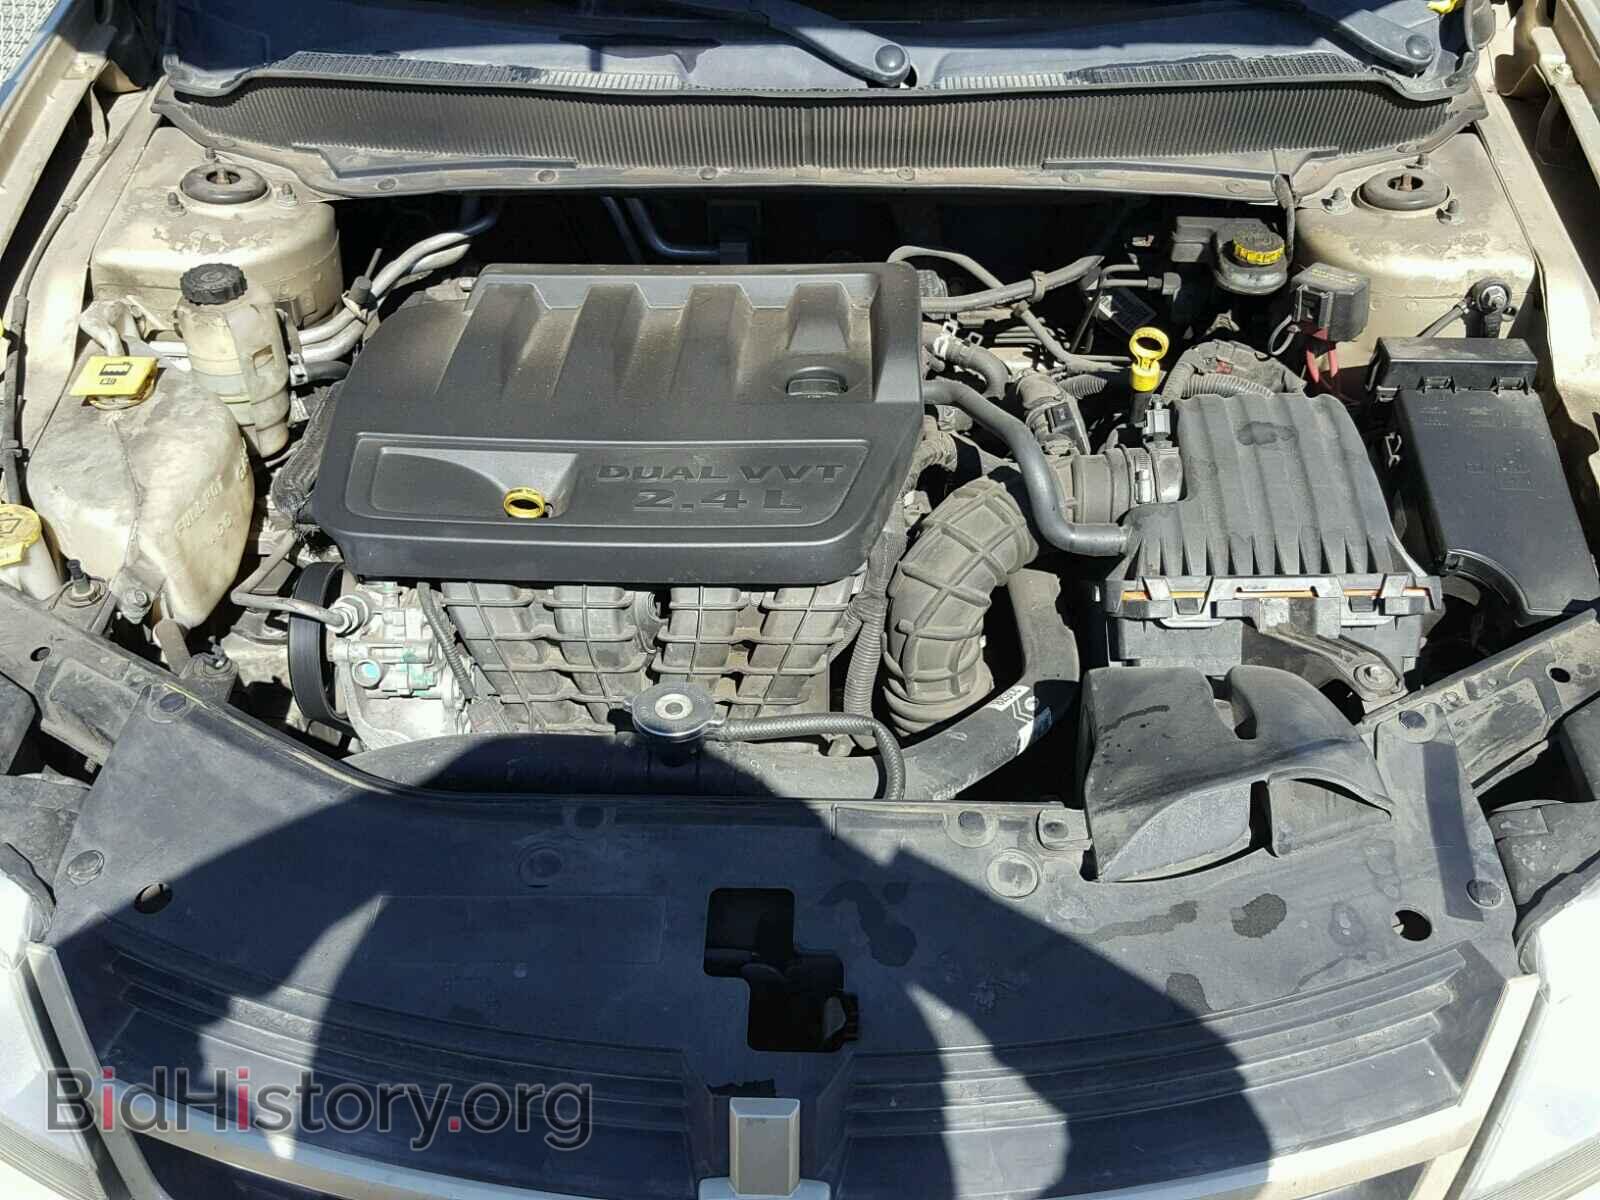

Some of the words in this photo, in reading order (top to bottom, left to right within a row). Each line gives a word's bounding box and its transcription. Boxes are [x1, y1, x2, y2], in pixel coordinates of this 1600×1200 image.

[597, 465, 729, 482] DUAL
[738, 464, 844, 483] VVT
[633, 489, 803, 512] 2.4L
